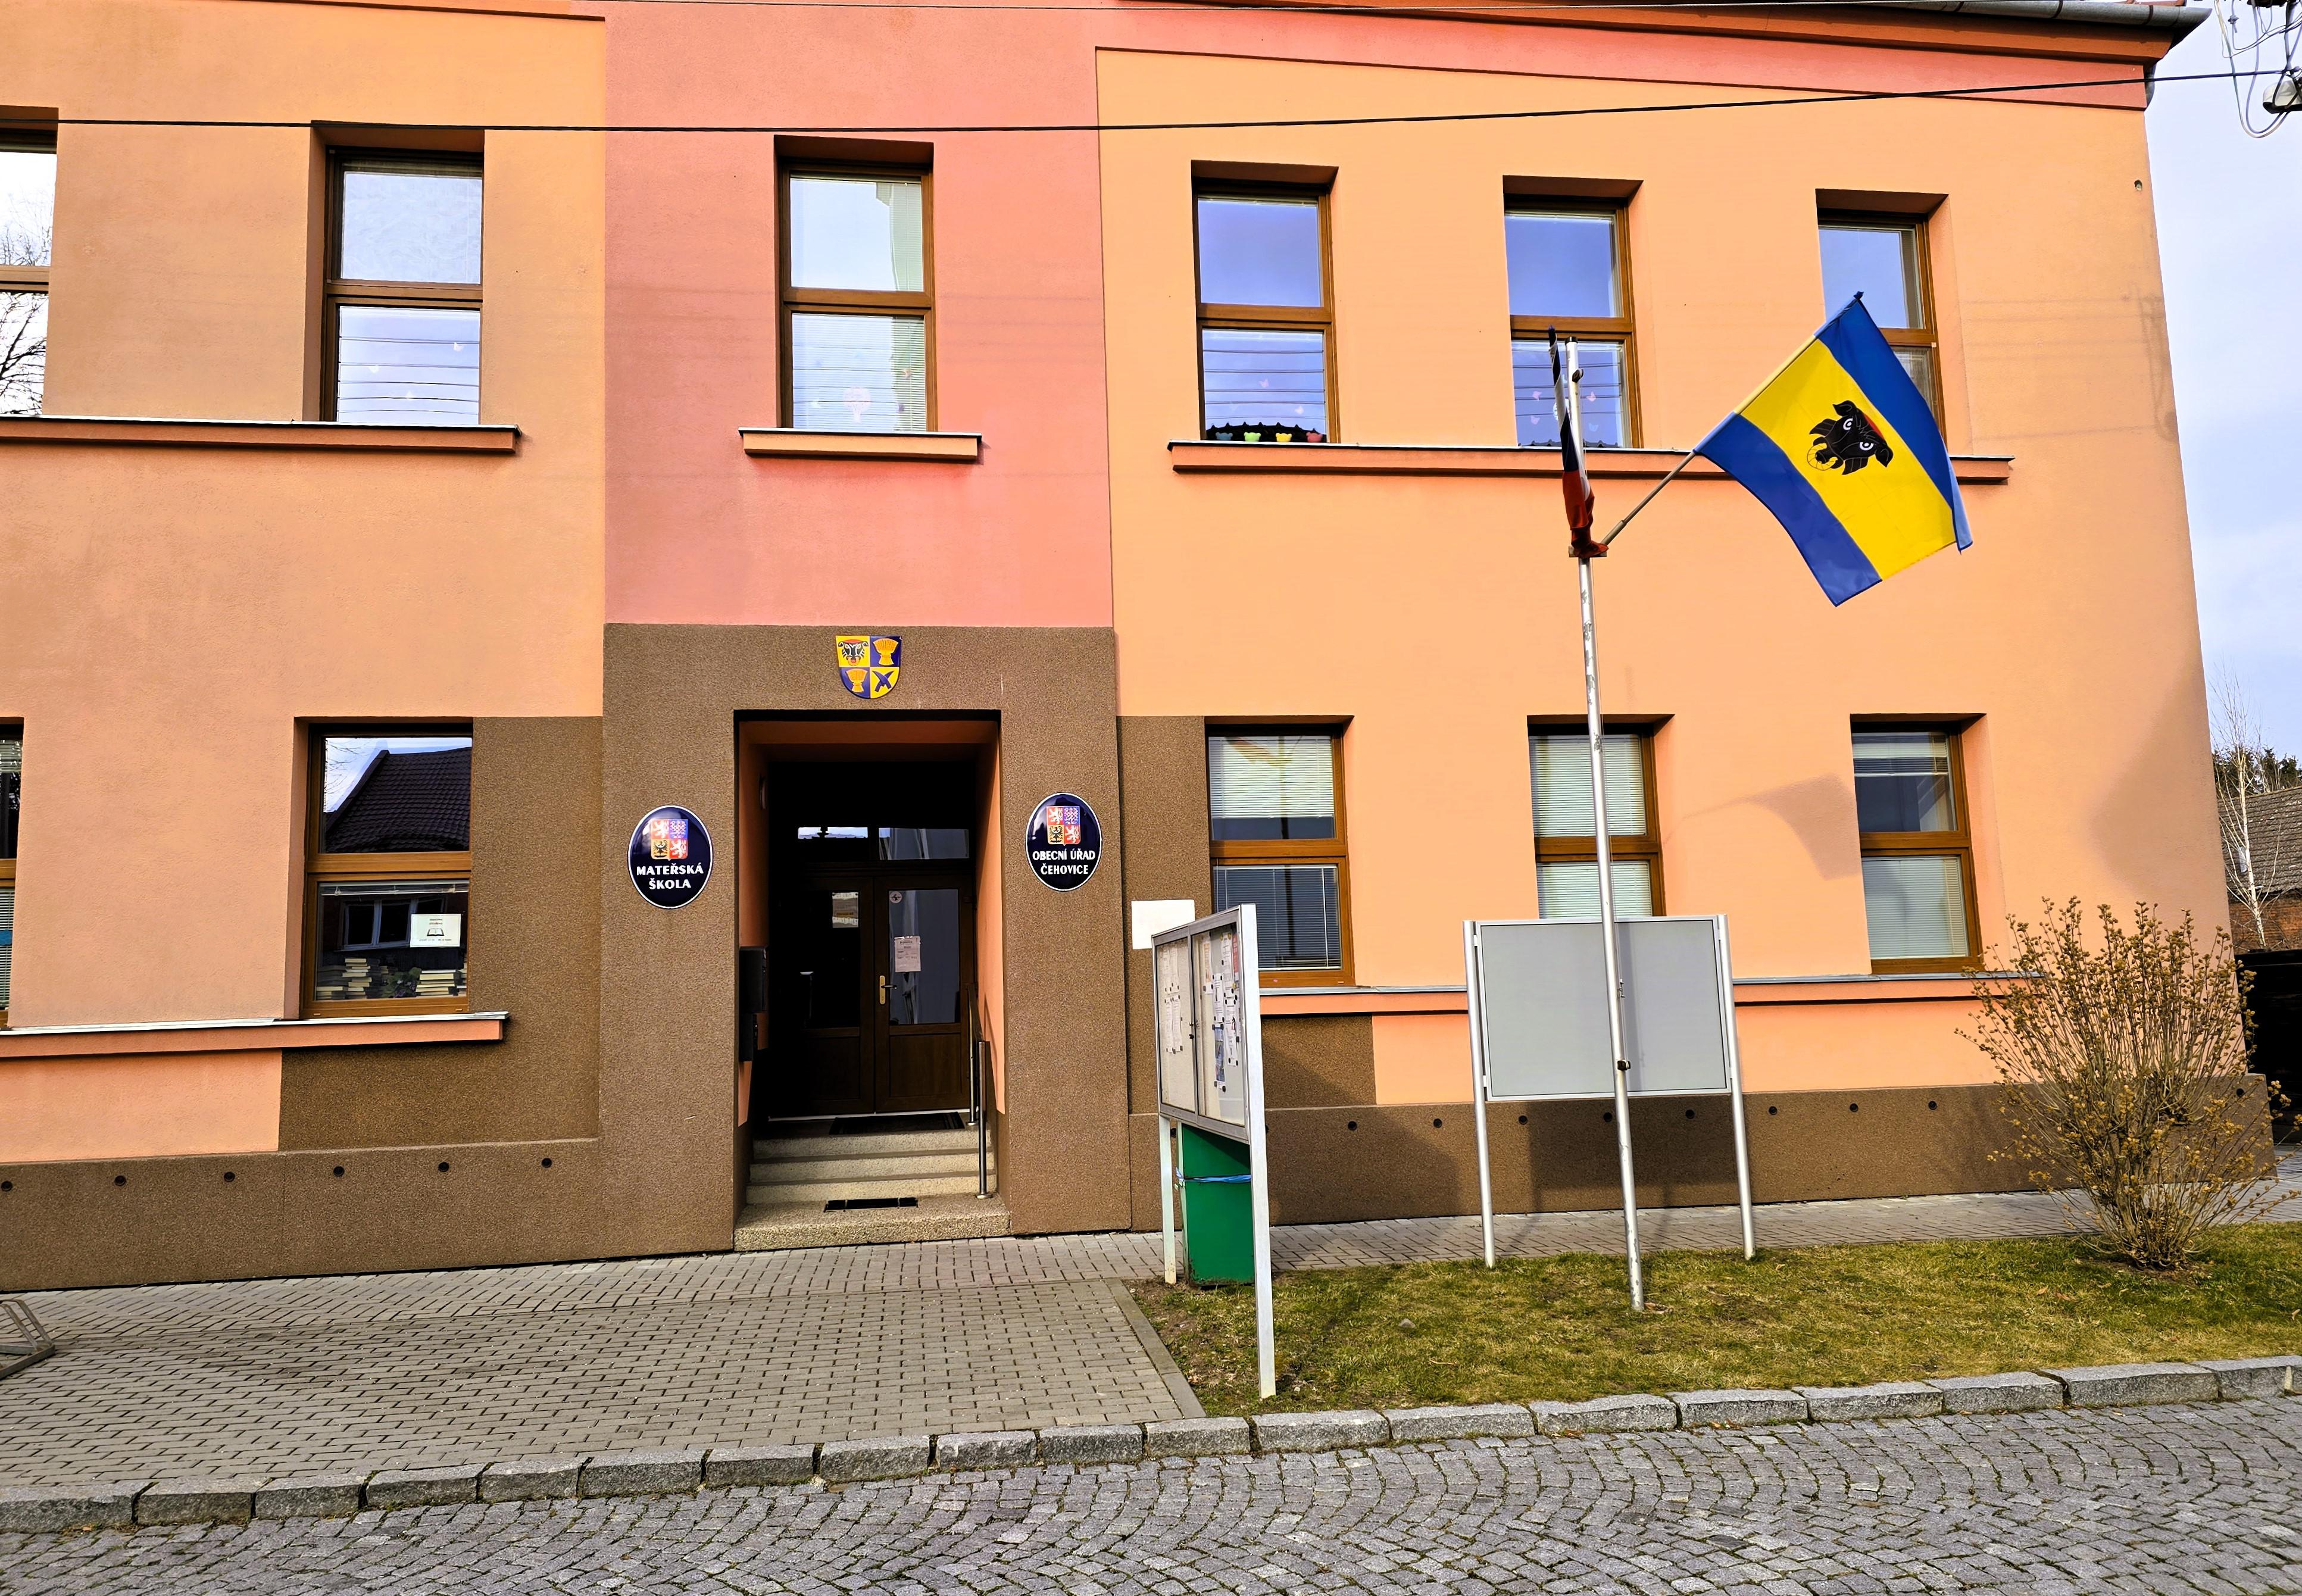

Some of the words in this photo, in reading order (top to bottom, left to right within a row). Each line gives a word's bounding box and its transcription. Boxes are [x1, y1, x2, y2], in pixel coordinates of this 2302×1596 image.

[1032, 848, 1067, 861] OBECNÍ
[1070, 848, 1096, 860] ÚŘAD
[637, 863, 704, 876] MATEŘSKÁ
[1041, 863, 1089, 875] ČEHOVICE
[649, 877, 692, 890] ŠKOLA
